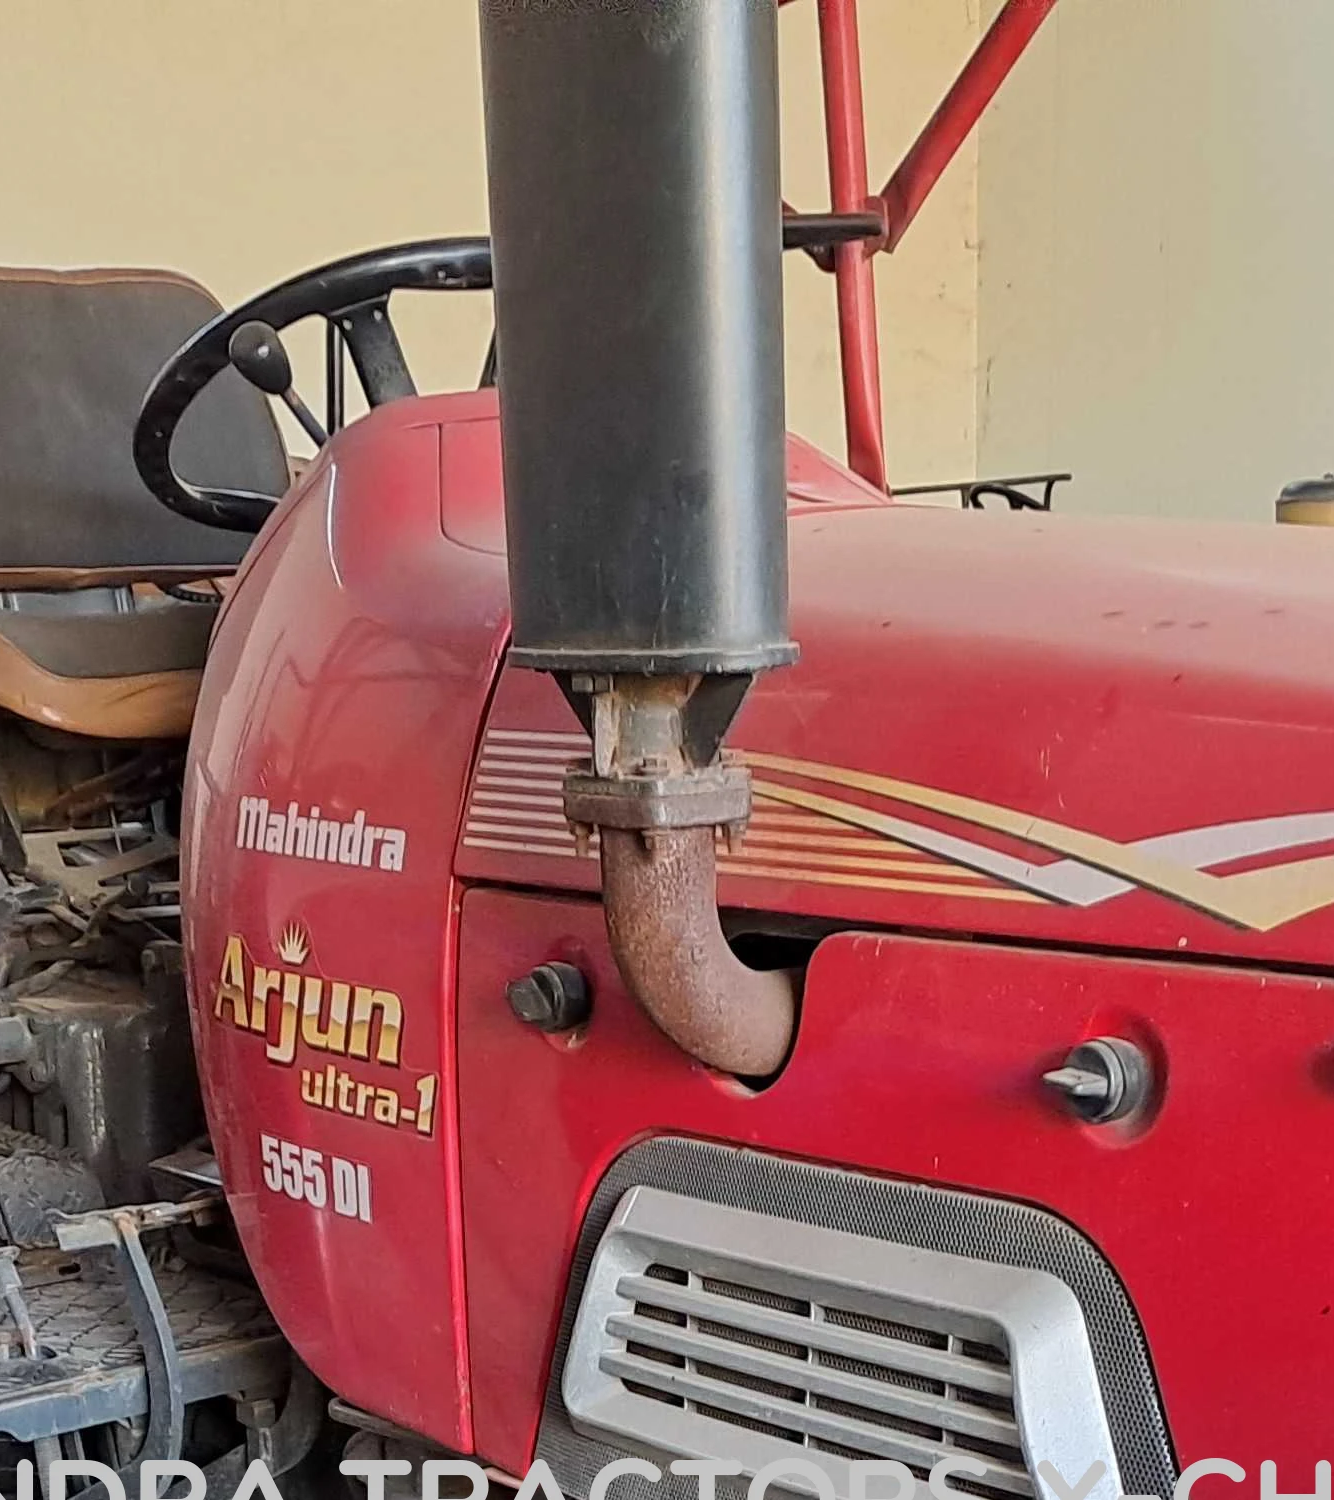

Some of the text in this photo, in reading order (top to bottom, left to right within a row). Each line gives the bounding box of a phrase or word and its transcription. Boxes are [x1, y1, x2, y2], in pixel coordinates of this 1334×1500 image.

[236, 795, 406, 872] Mahindra
[214, 932, 404, 1065] Arjun
[300, 1065, 437, 1138] ultra-1
[260, 1133, 373, 1224] 555 DI
